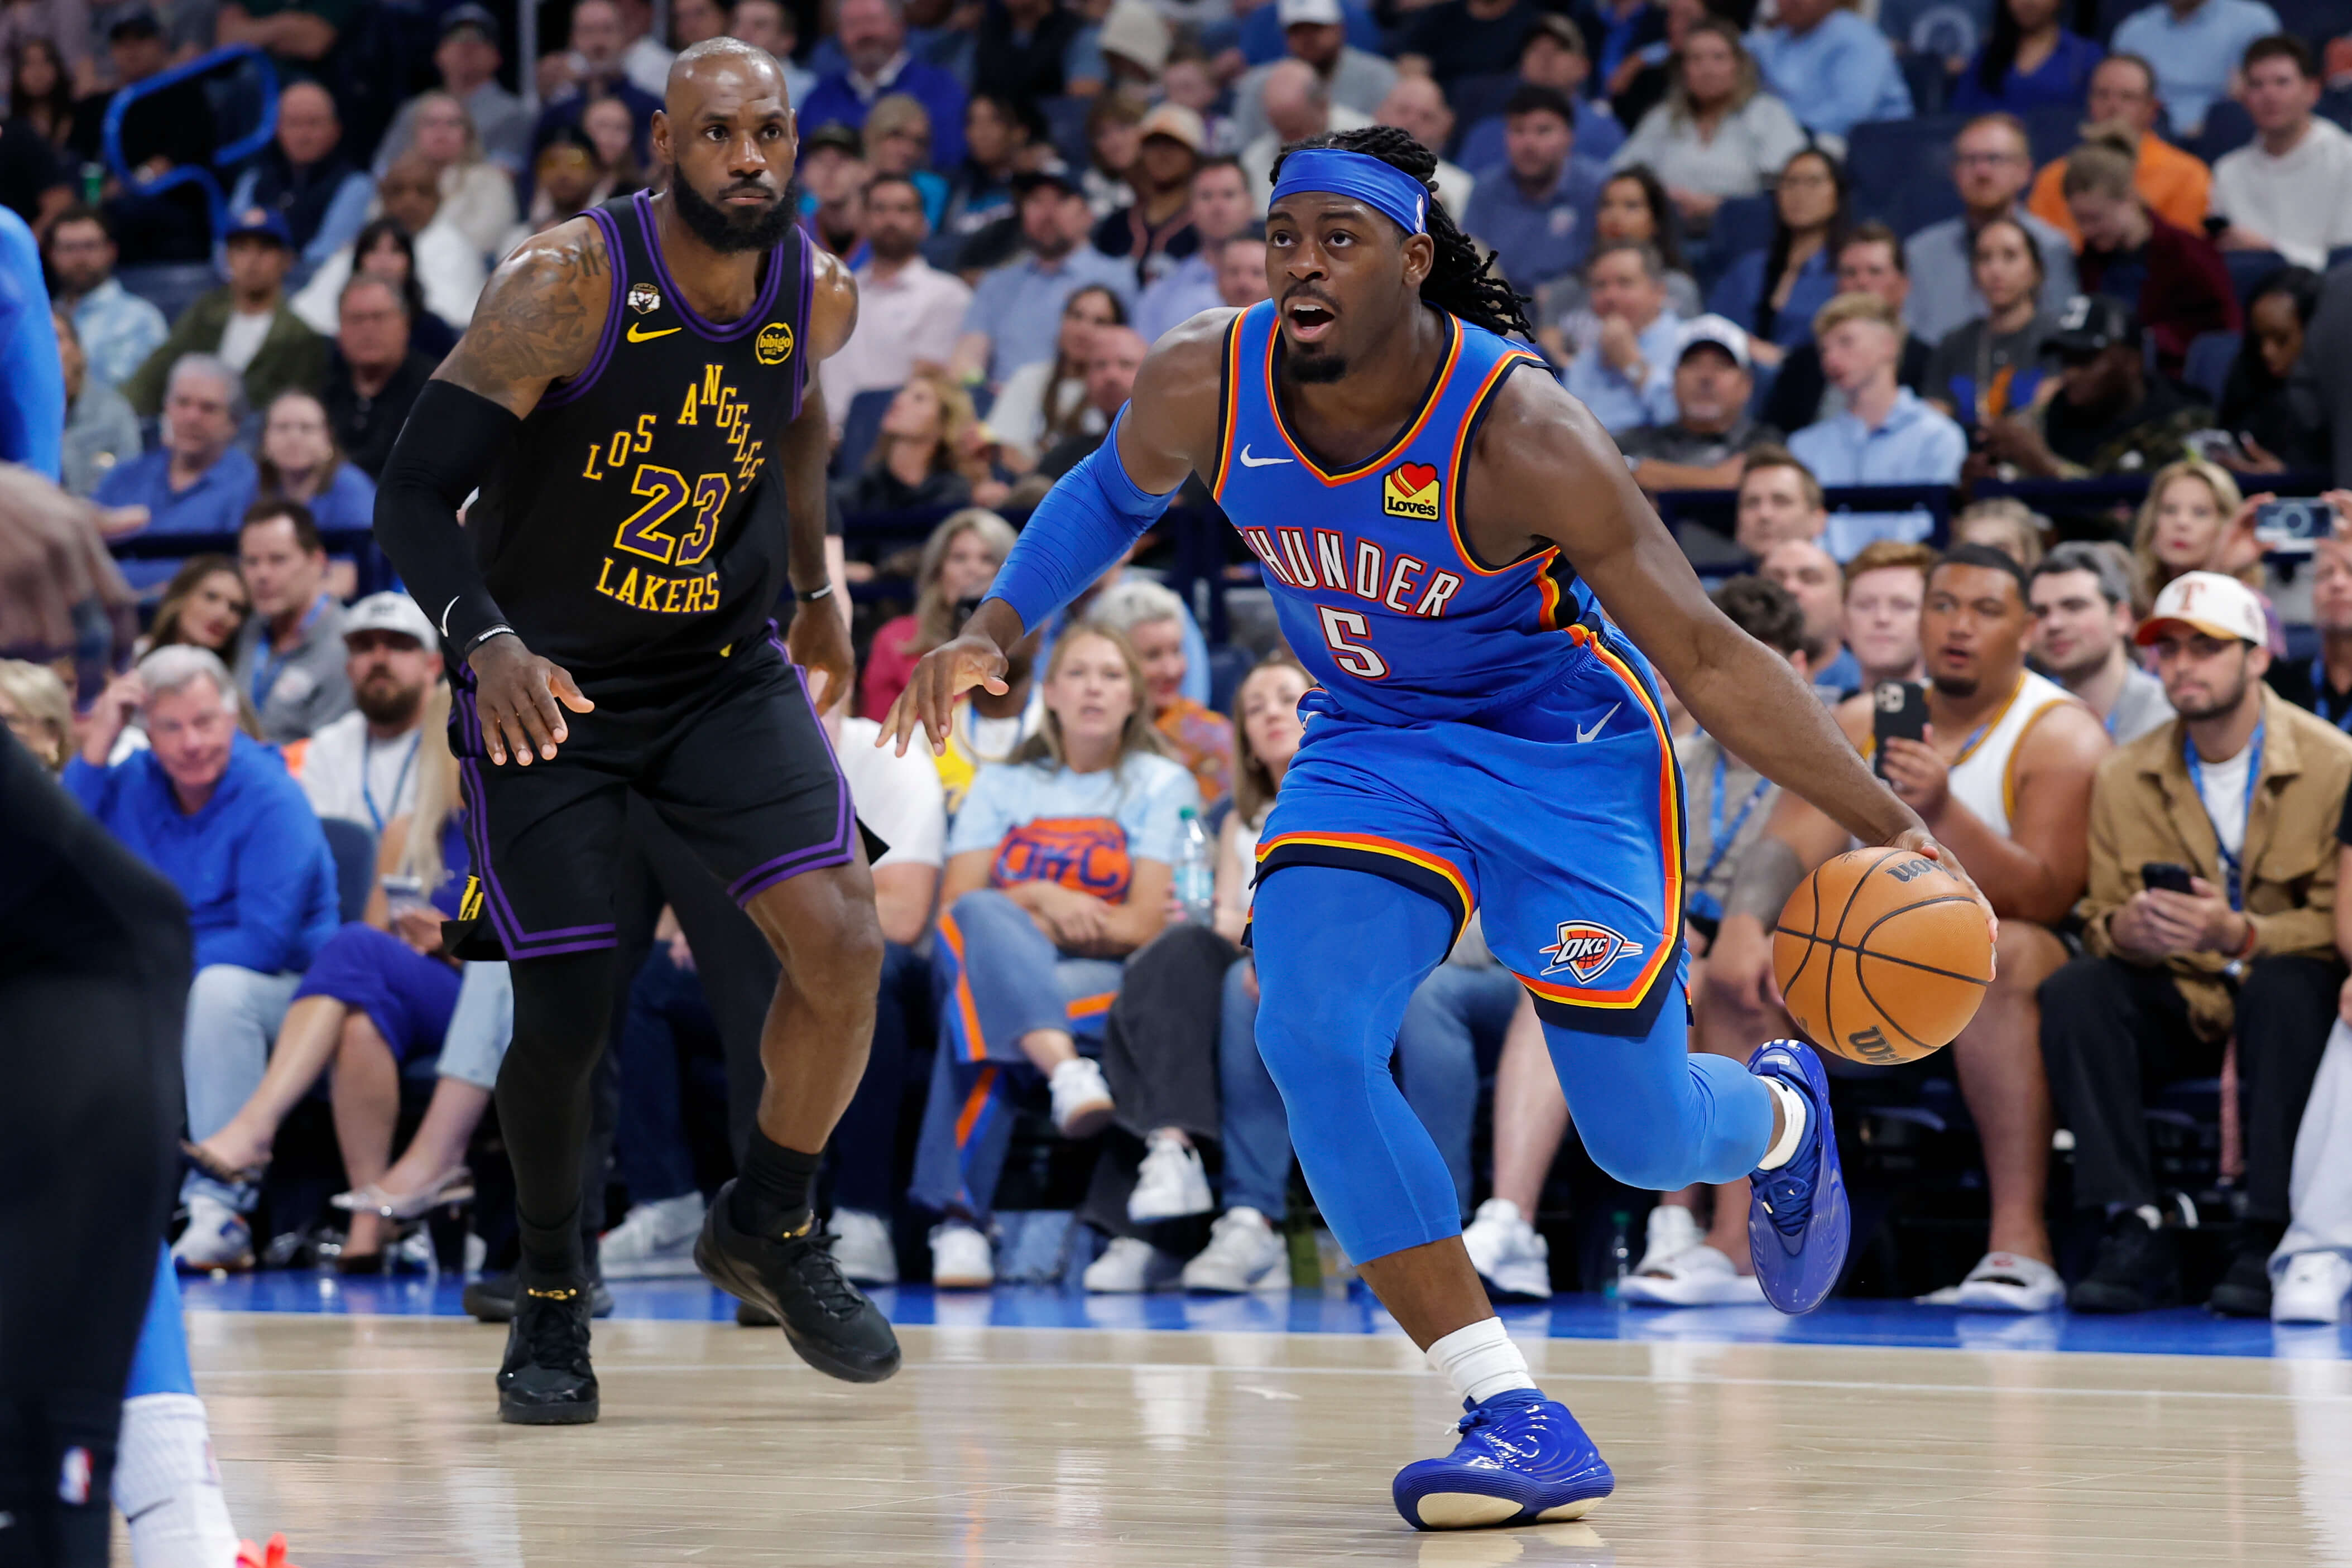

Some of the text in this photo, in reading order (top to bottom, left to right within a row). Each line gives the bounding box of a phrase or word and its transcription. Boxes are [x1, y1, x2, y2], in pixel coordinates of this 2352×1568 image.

[759, 334, 790, 353] bibigo
[583, 364, 764, 493] LOS ANGELES
[614, 464, 731, 566] 23
[596, 557, 719, 612] LAKERS
[1235, 526, 1463, 618] HUNDER
[1316, 604, 1390, 680] 5
[1554, 937, 1608, 964] OKC
